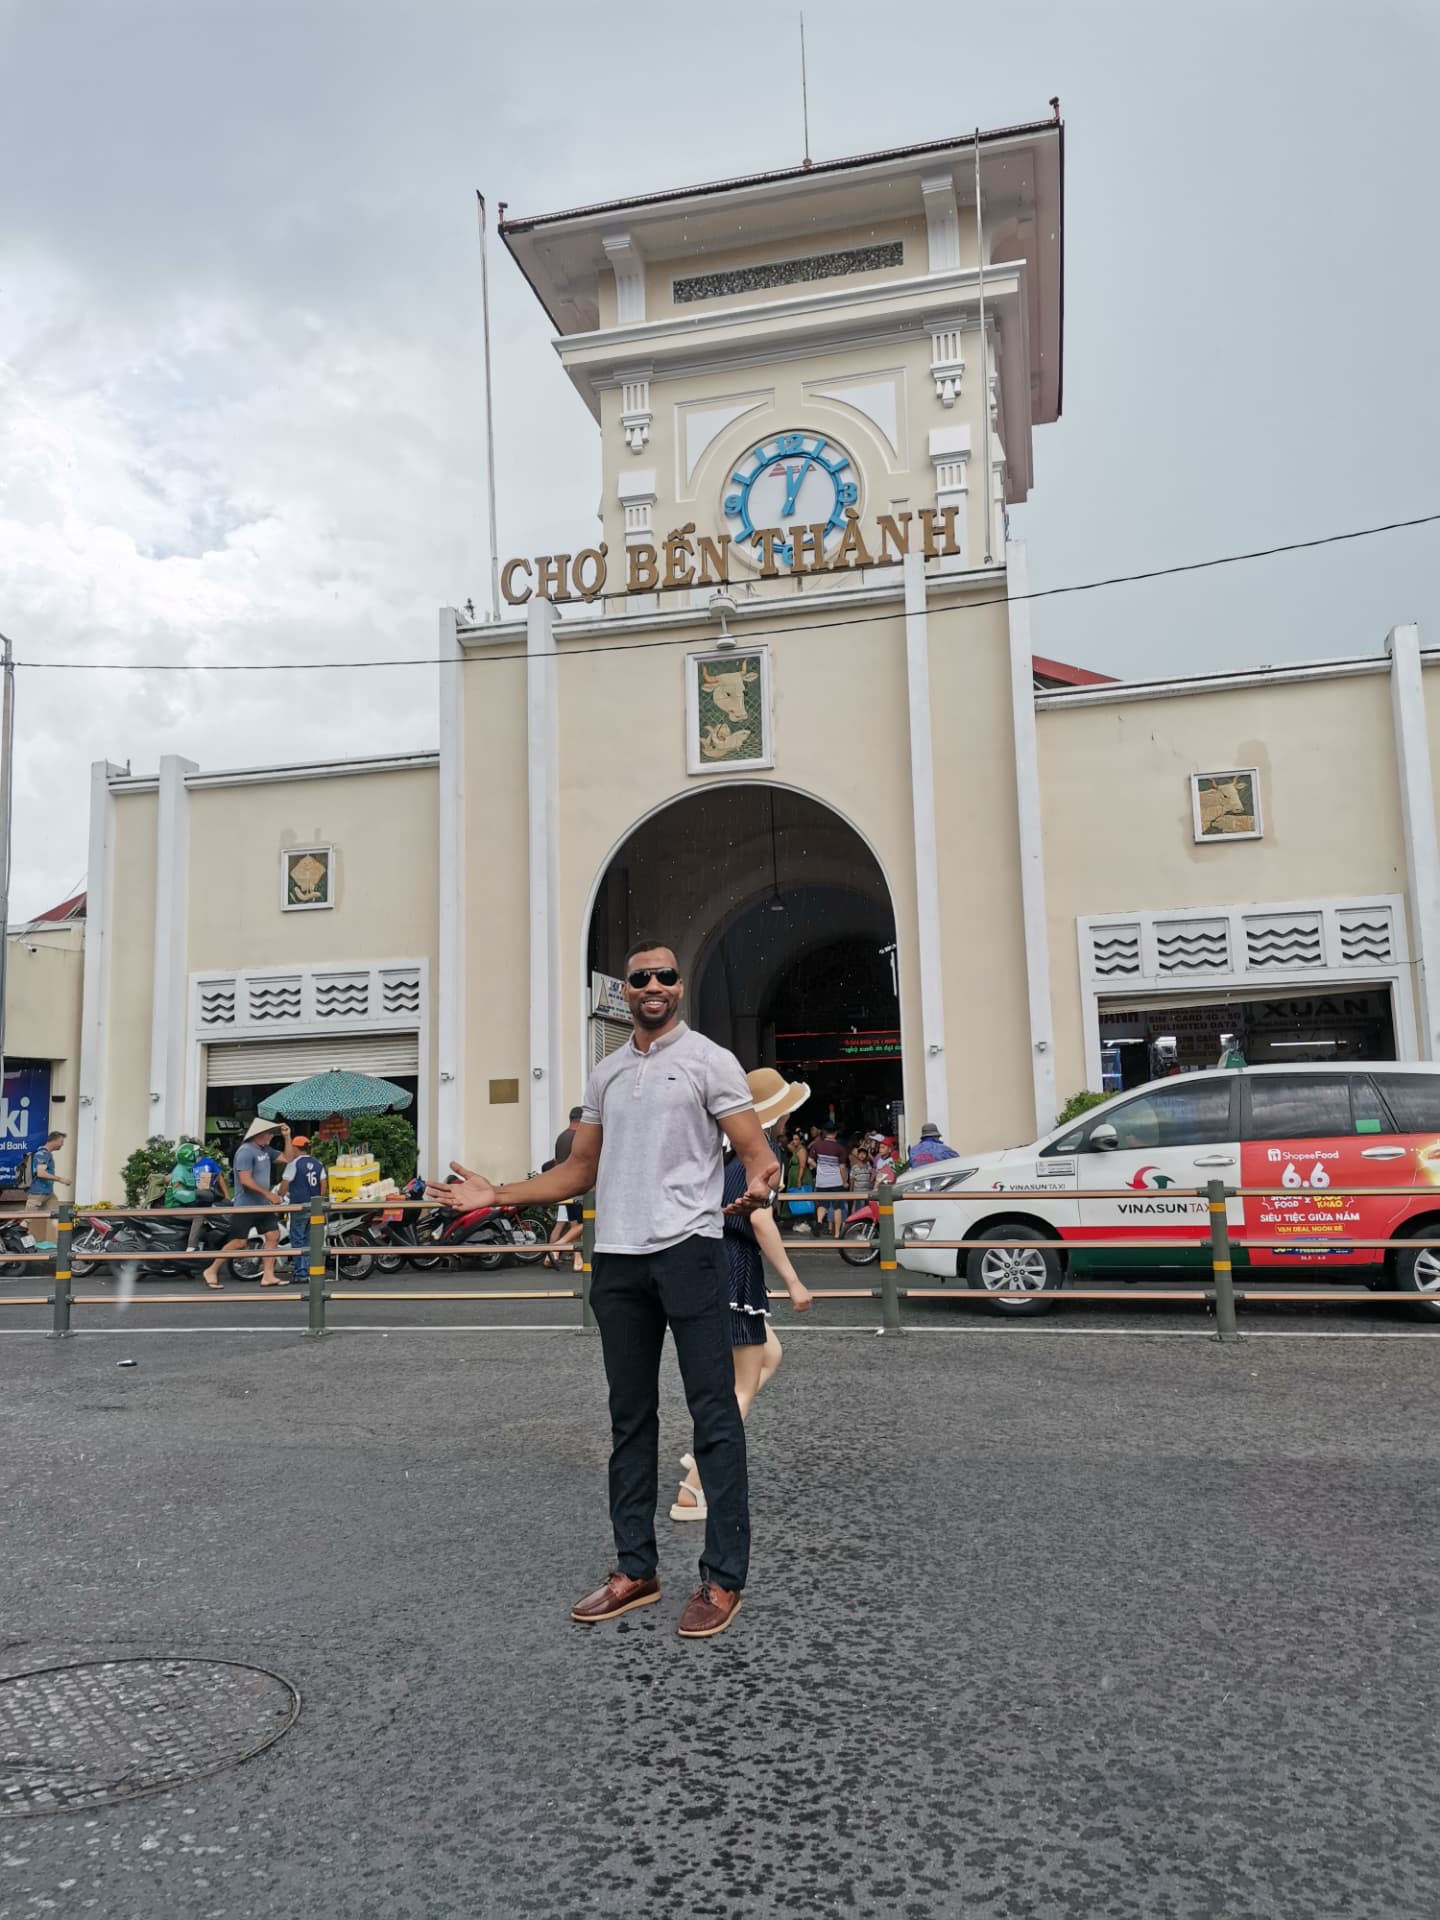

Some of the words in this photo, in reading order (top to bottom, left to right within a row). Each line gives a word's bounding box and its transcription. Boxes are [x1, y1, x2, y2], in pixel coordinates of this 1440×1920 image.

[776, 433, 804, 455] 12
[839, 482, 858, 505] 3
[724, 494, 742, 516] 9
[500, 541, 609, 605] CHỢ
[627, 522, 731, 591] BẾN
[751, 506, 962, 577] THÀNH
[7, 1140, 28, 1151] Bank
[1282, 1150, 1340, 1161] ShopeeFood
[306, 1171, 318, 1187] 16
[1282, 1162, 1330, 1189] 6.6
[1009, 1183, 1048, 1191] VINASUN
[1118, 1203, 1188, 1214] VINASUN
[1274, 1200, 1299, 1209] FOOD
